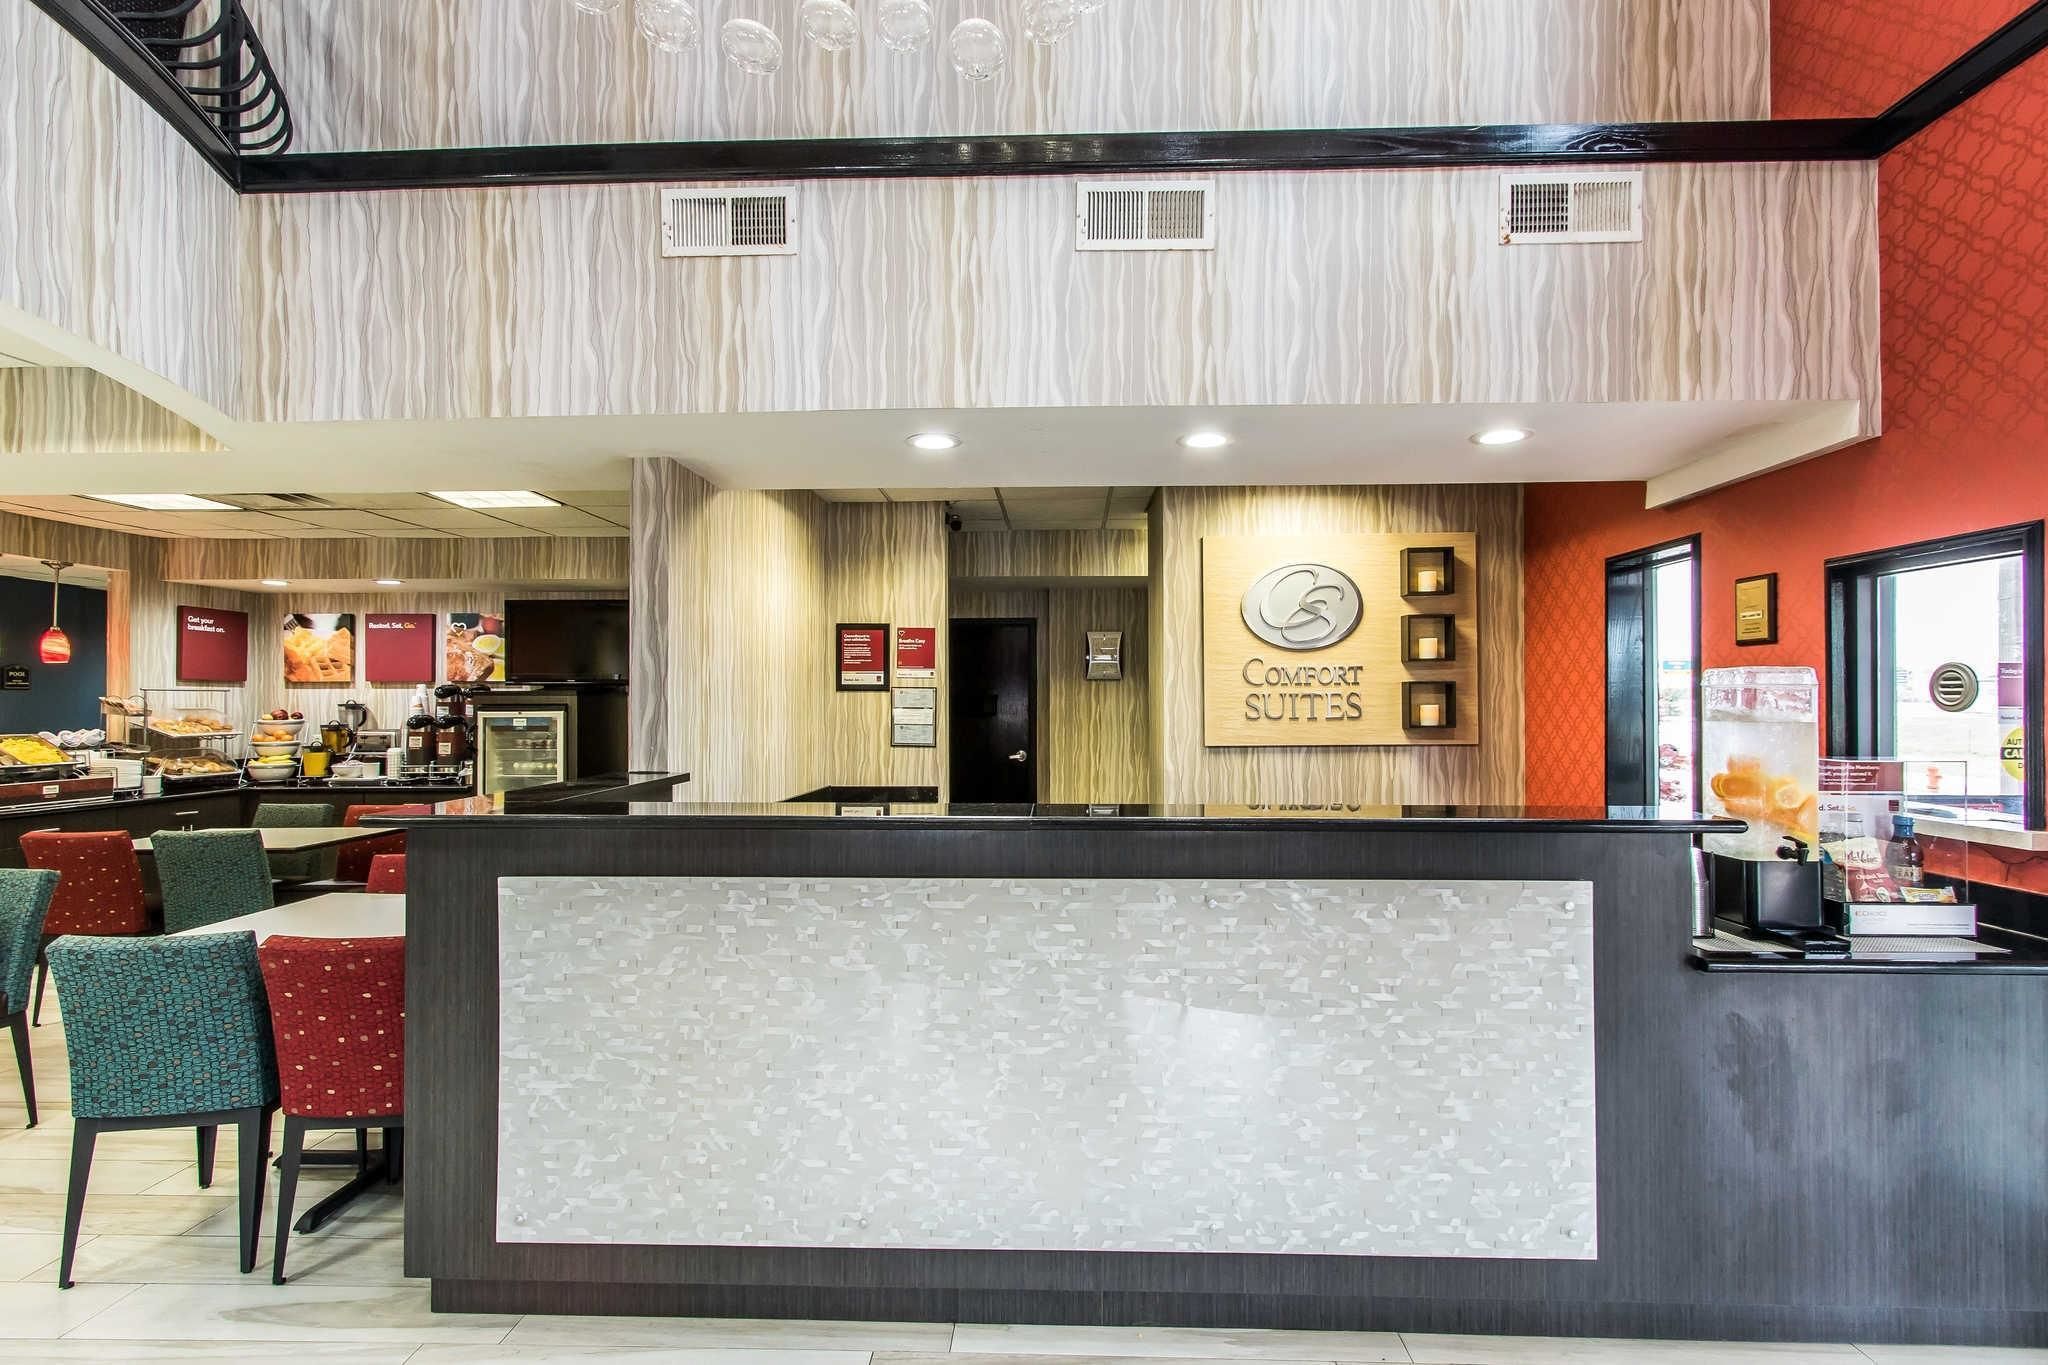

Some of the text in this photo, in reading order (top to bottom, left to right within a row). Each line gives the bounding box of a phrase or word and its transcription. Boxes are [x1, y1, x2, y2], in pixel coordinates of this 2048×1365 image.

[187, 623, 216, 632] breakfast
[1242, 657, 1364, 687] COMFORT
[1244, 692, 1363, 722] SUITES
